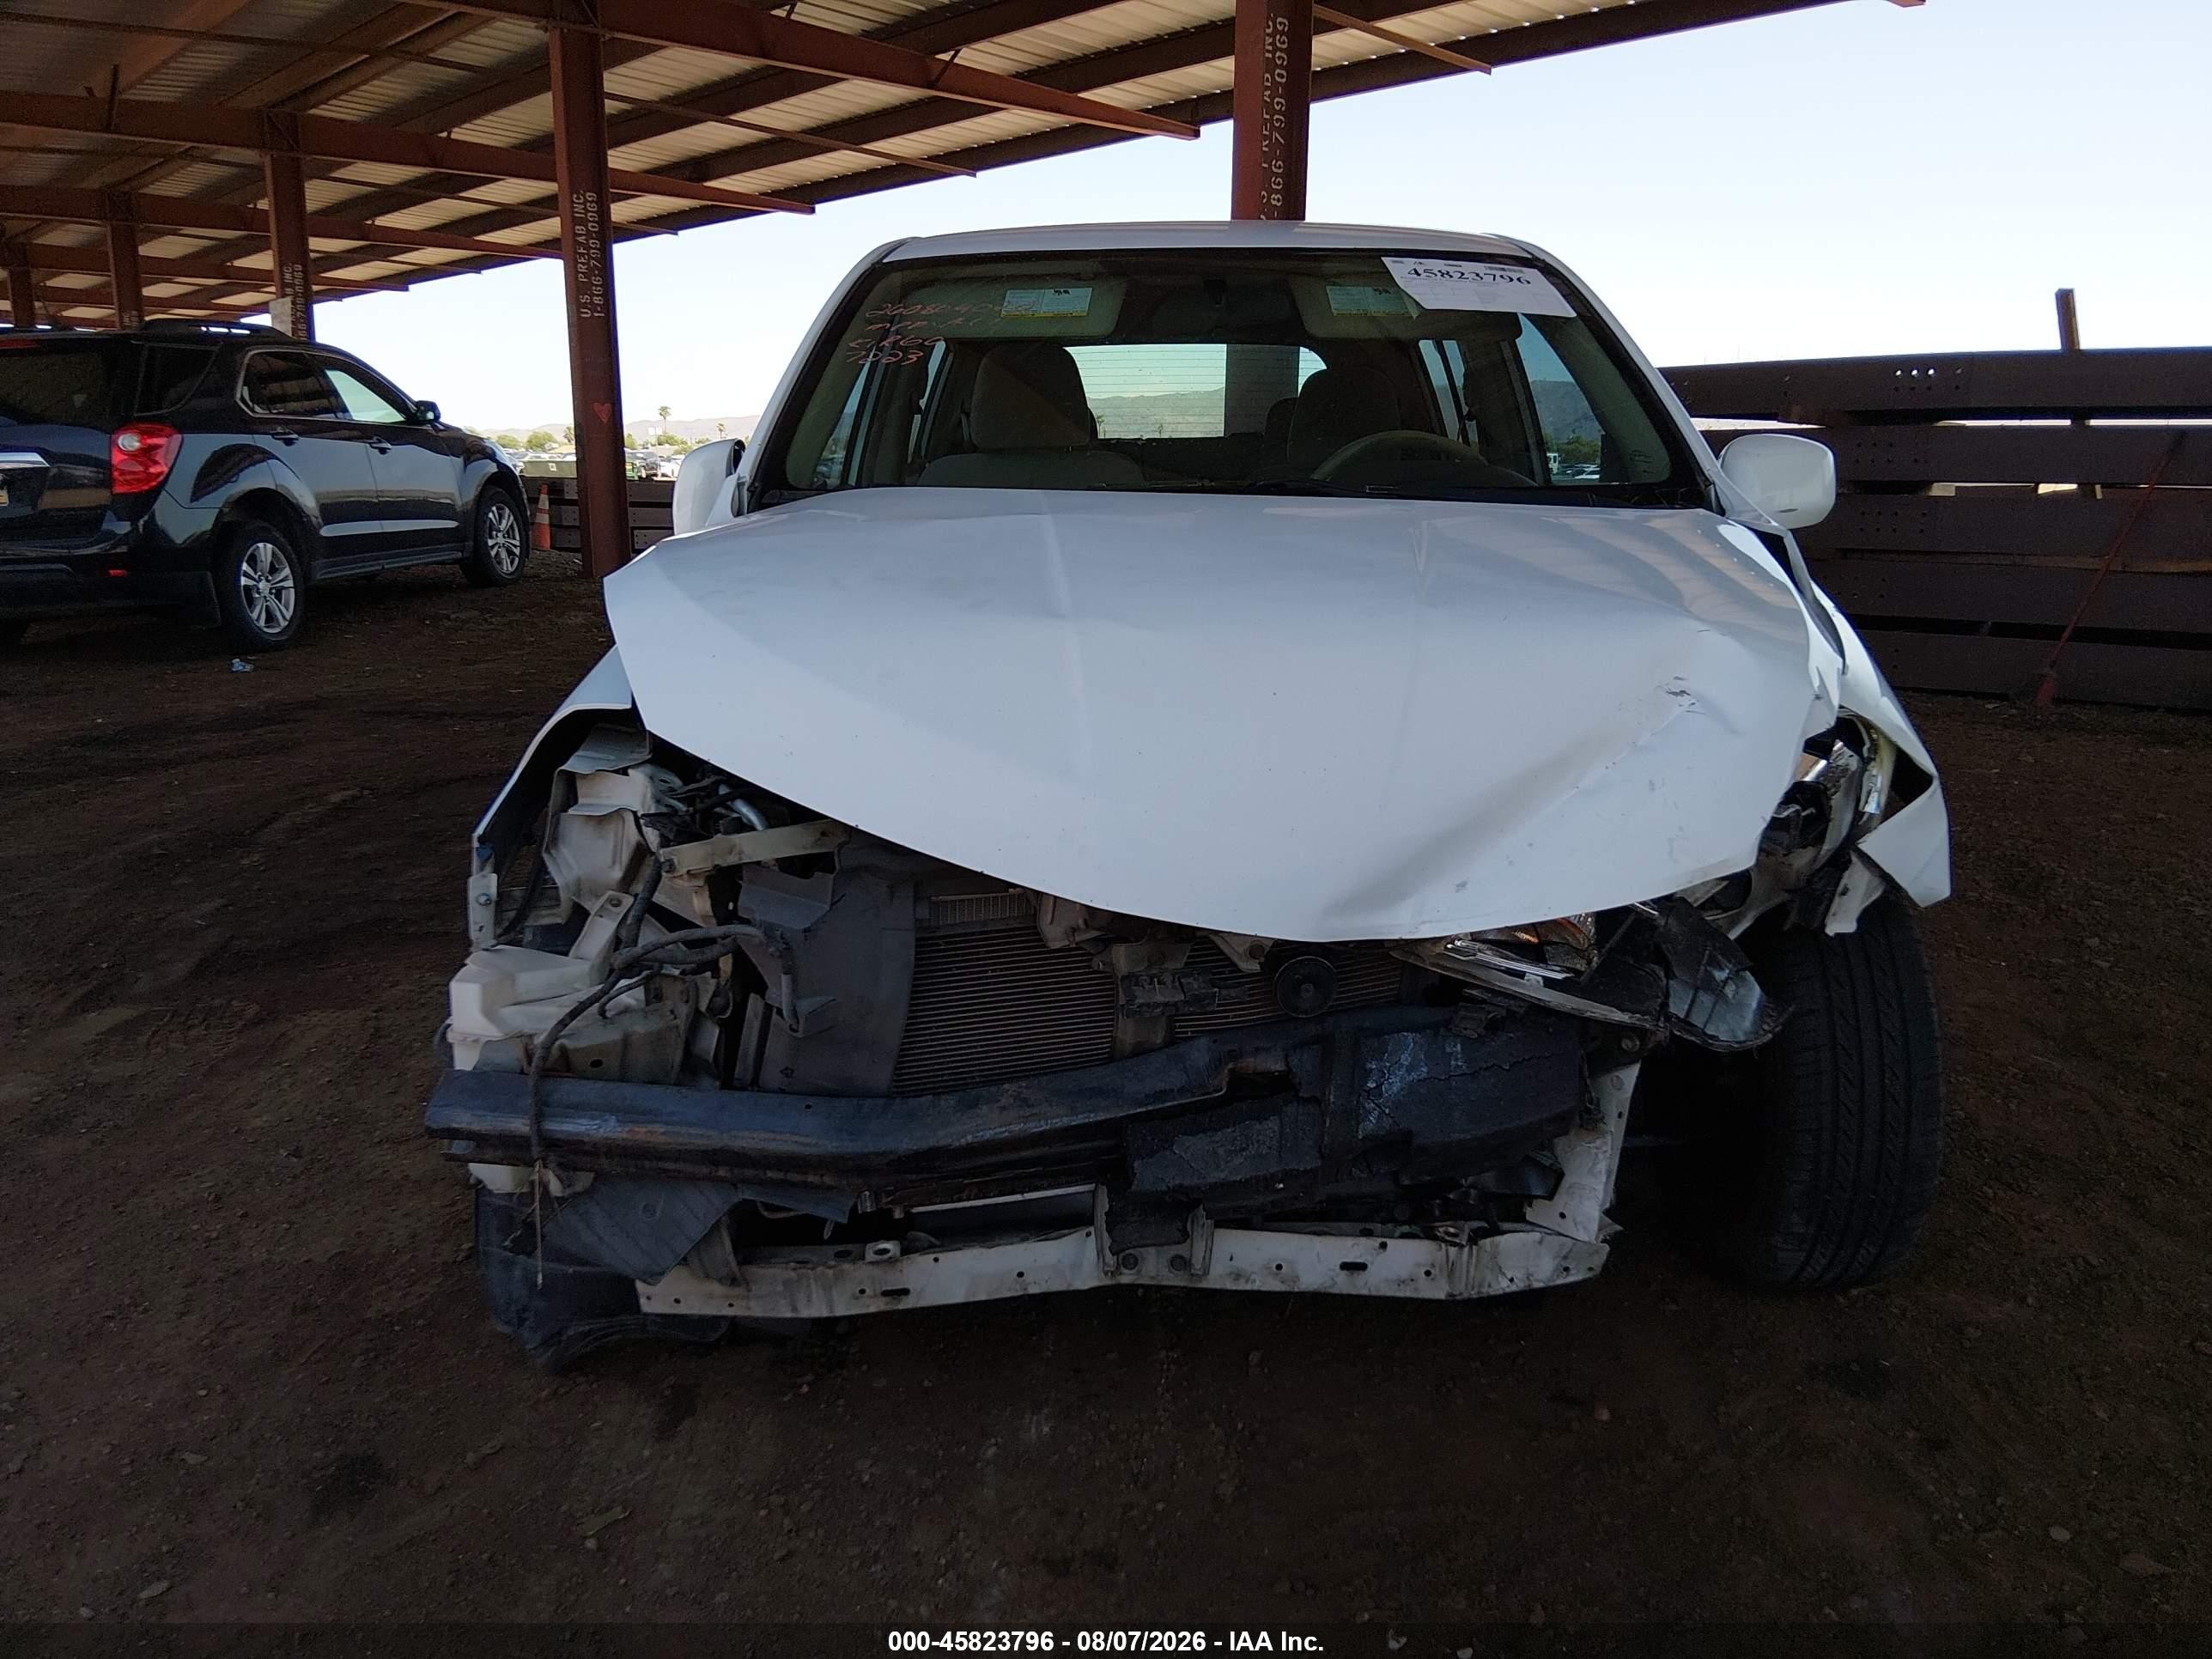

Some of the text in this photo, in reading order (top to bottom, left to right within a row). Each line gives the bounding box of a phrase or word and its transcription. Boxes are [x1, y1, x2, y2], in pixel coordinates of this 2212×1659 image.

[573, 190, 592, 318] U.S. PREFAB INC.
[586, 191, 605, 318] 1-866-799-0969
[1407, 267, 1532, 286] 45823796
